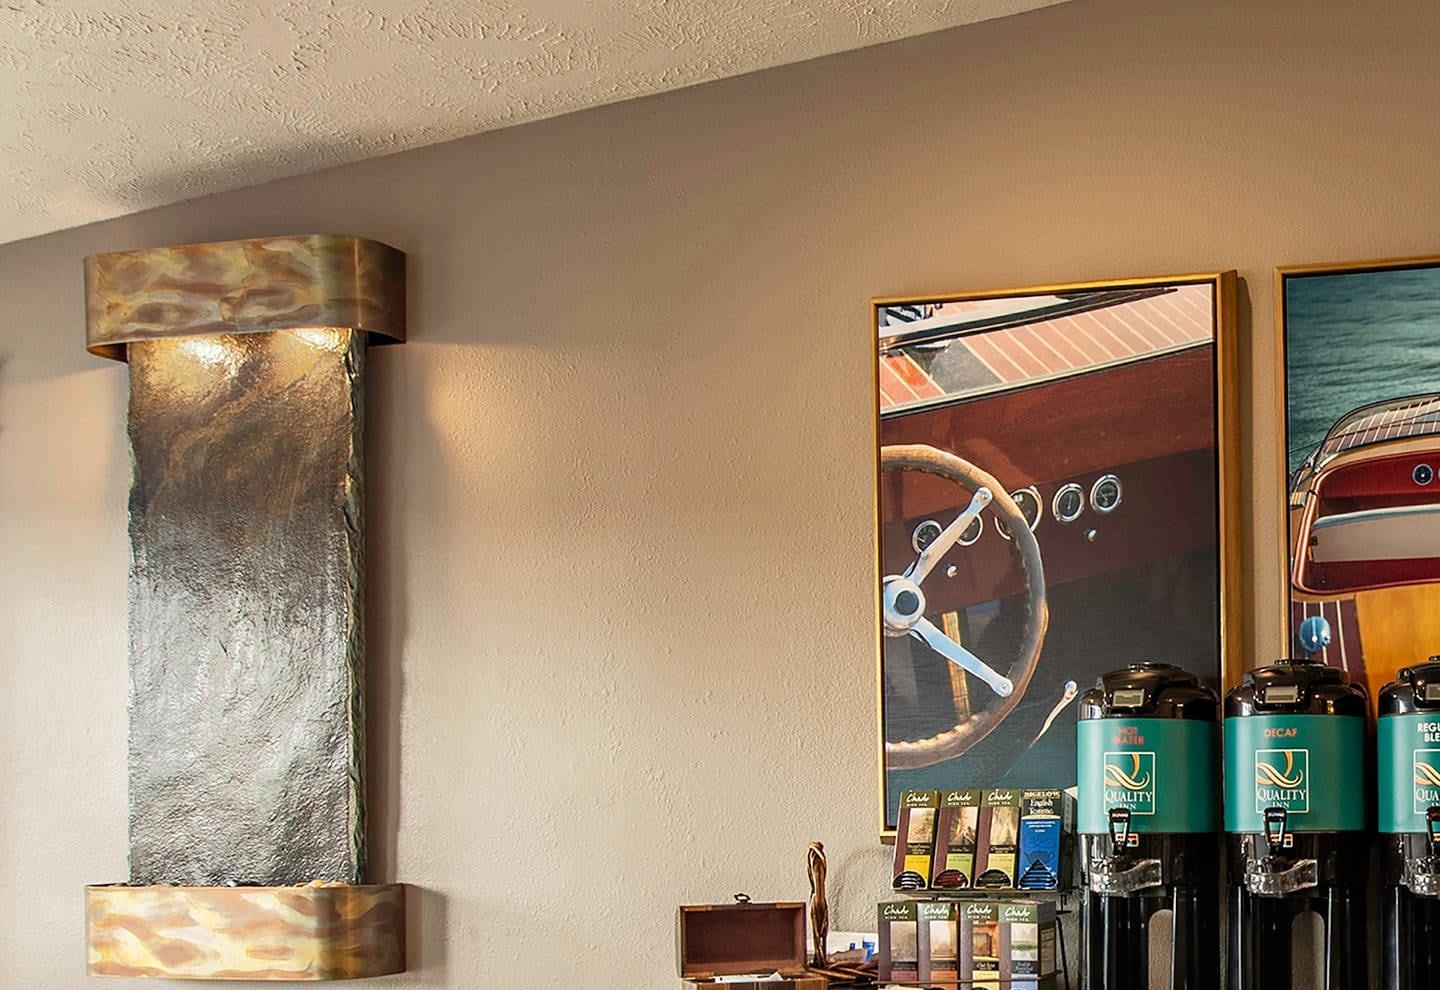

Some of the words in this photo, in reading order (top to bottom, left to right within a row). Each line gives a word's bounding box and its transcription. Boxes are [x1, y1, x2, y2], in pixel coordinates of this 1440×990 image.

[1264, 728, 1298, 738] DECAF
[1105, 790, 1153, 804] QUALITY
[1257, 787, 1306, 802] QUALITY
